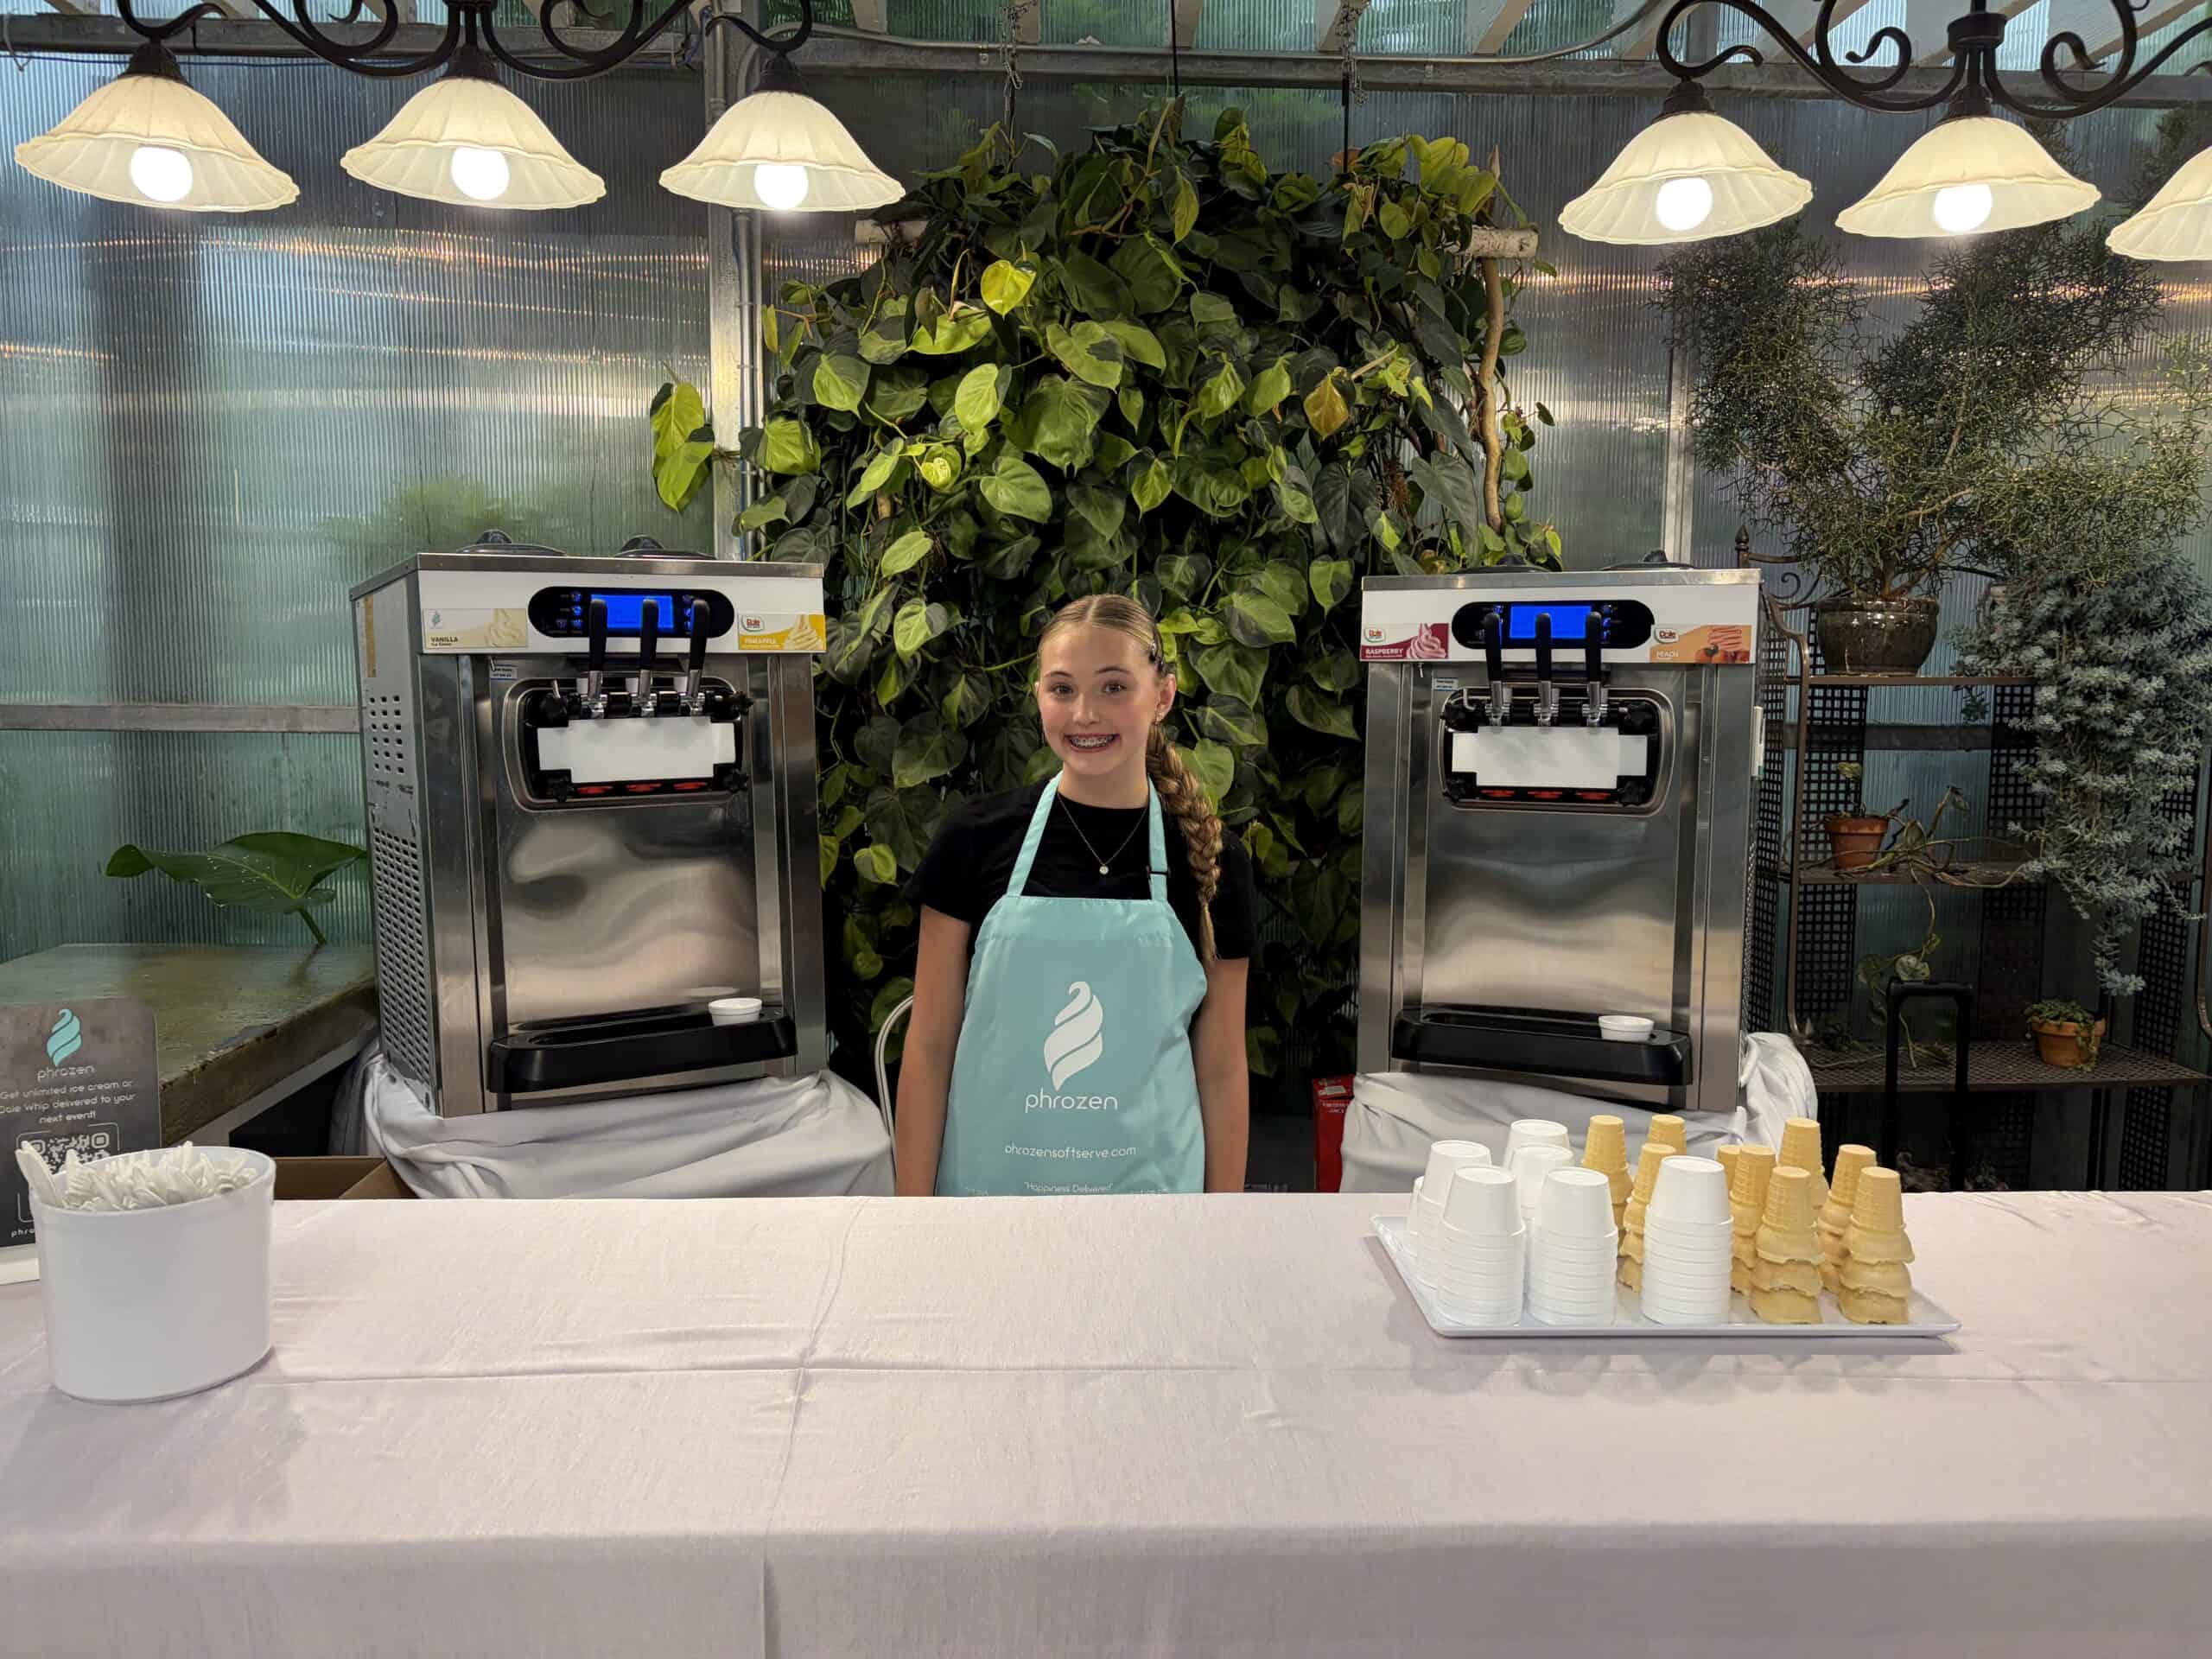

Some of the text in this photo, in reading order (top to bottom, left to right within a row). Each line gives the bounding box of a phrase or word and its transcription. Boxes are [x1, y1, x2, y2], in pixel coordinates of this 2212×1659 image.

[37, 1065, 95, 1081] phrozen
[0, 1091, 19, 1100] Get
[22, 1084, 67, 1098] unlimited
[87, 1082, 119, 1091] cream
[24, 1102, 49, 1112] Whip
[53, 1096, 98, 1109] delivered
[114, 1094, 136, 1104] your
[1025, 1087, 1118, 1114] phrozen
[39, 1115, 62, 1124] next
[1005, 1141, 1136, 1159] phrozensoftserve.com
